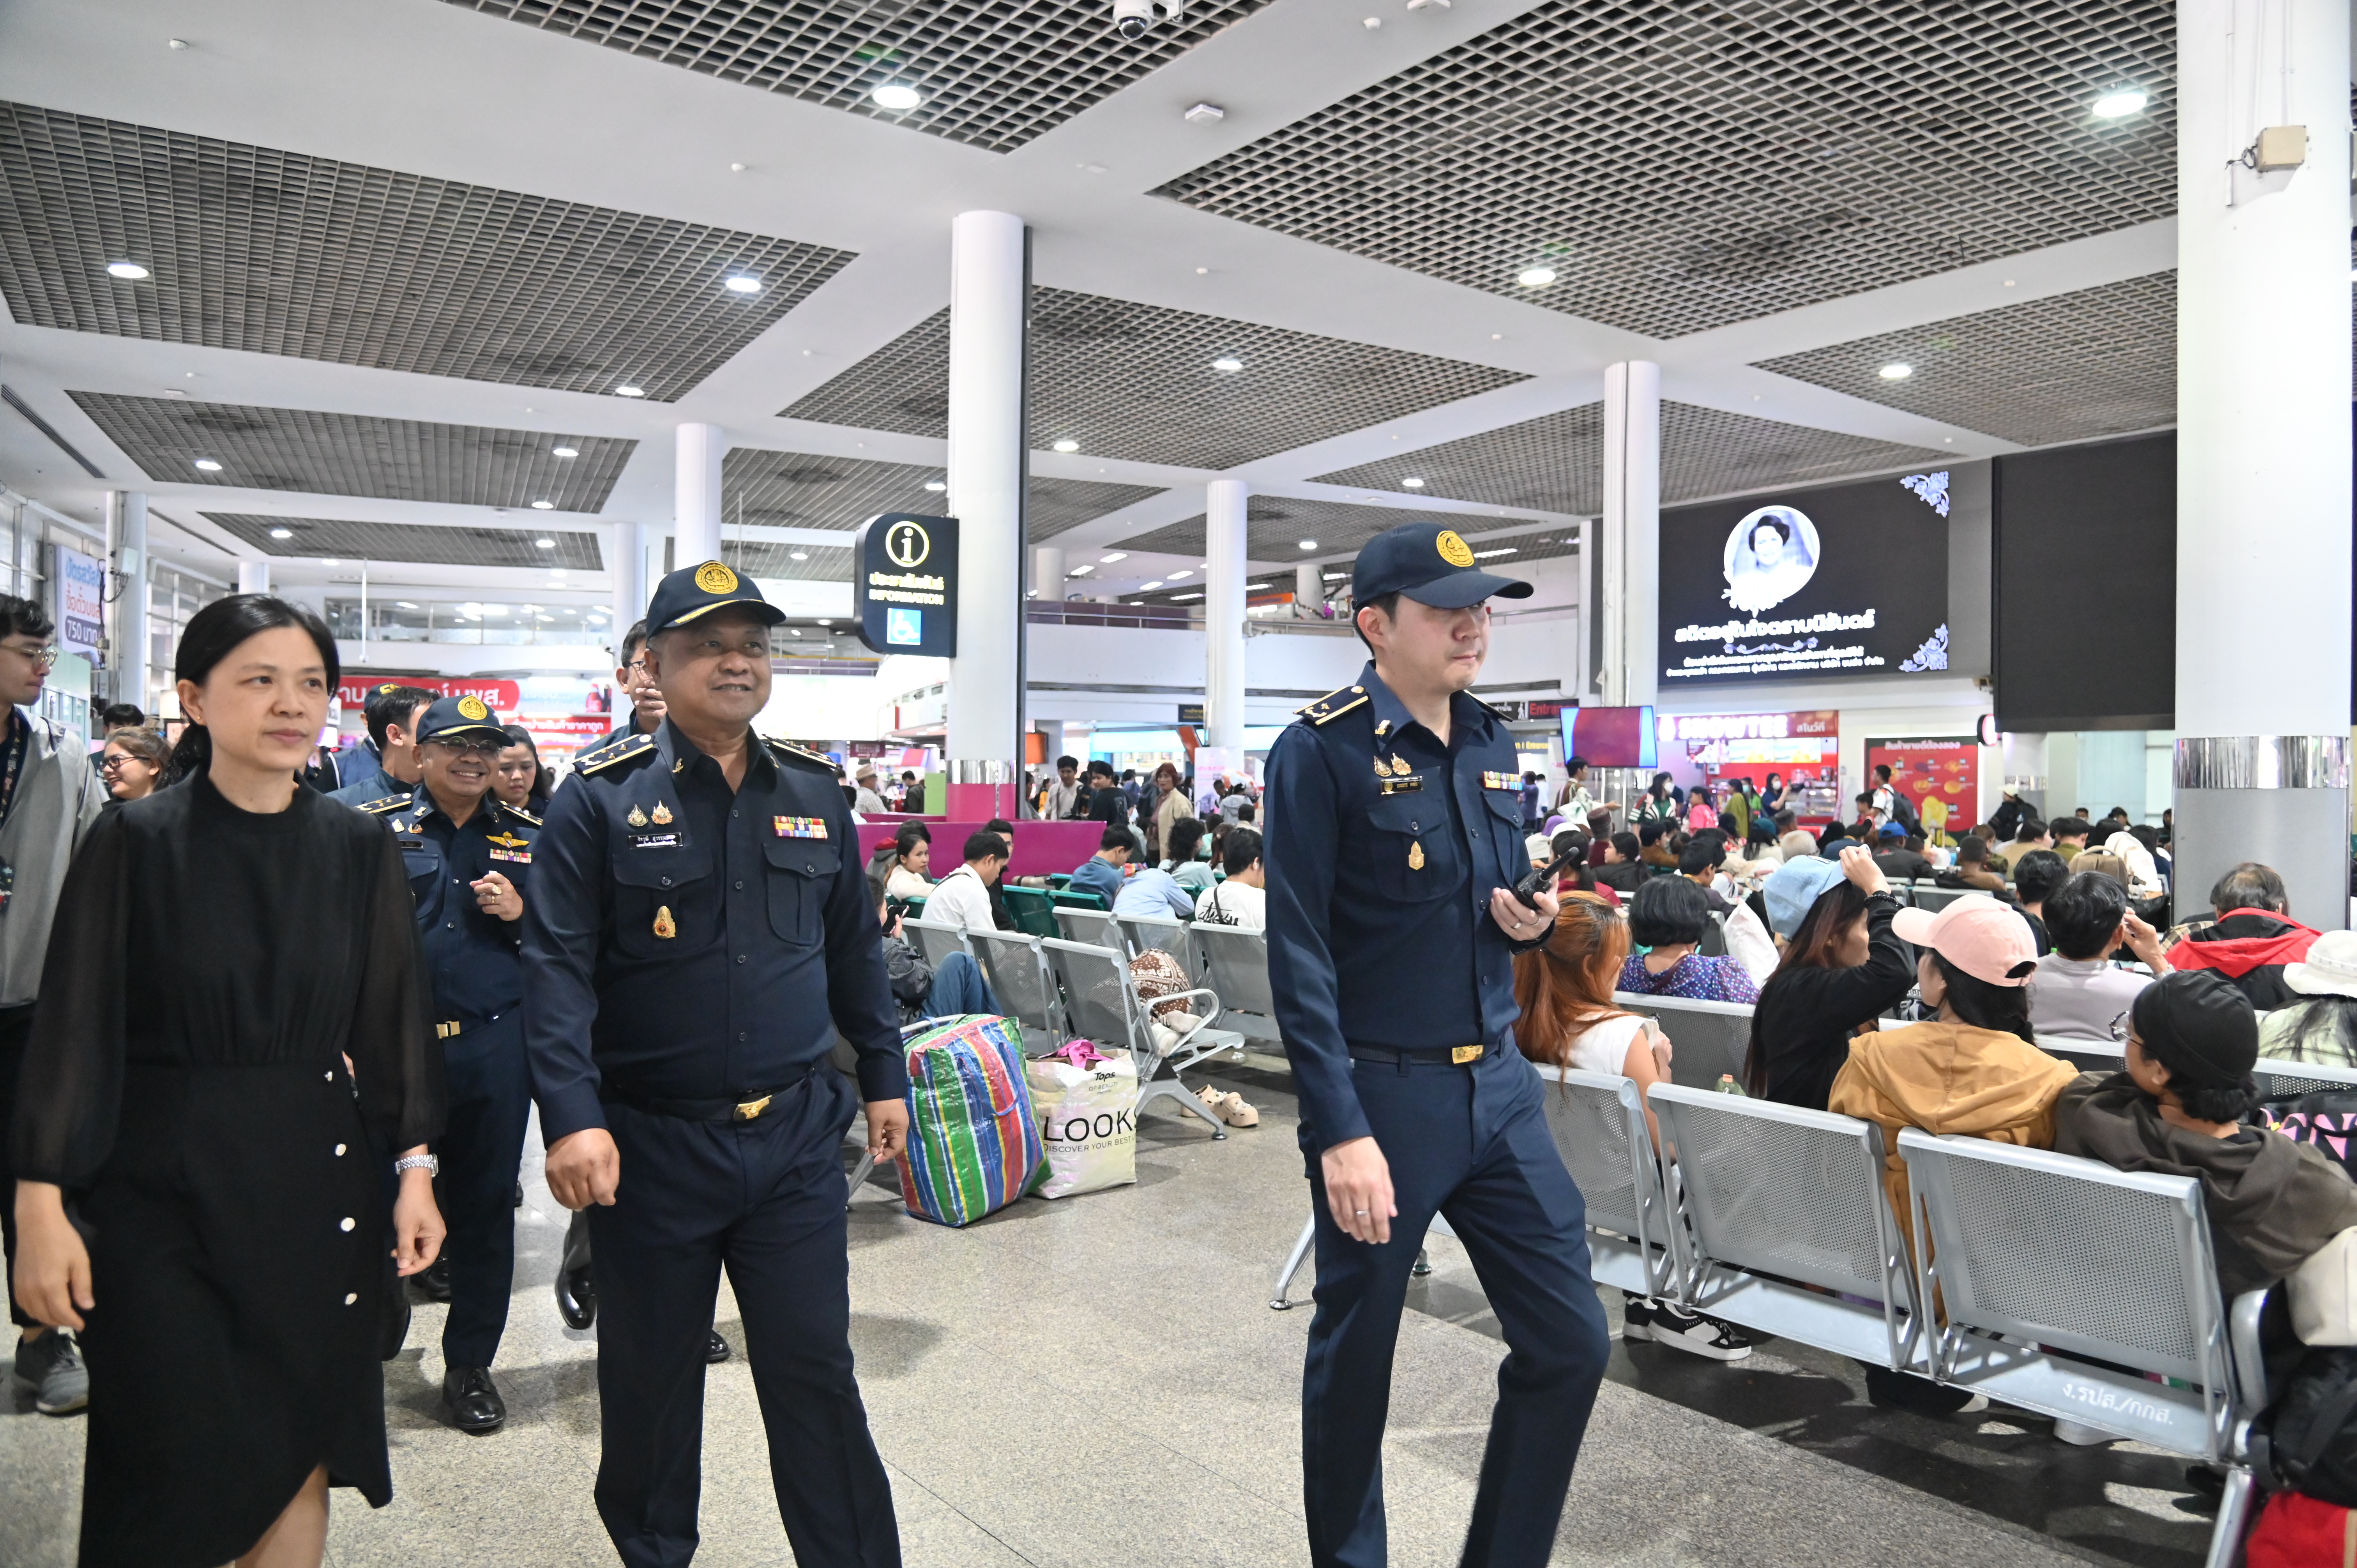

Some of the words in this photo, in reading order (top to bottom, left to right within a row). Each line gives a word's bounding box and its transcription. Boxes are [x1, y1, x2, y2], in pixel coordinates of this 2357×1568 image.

[869, 589, 944, 605] INFORMATION
[67, 620, 82, 640] 750
[1529, 703, 1576, 715] Entra
[1678, 715, 1788, 740] SNOWTEE
[1094, 1072, 1116, 1082] Tops
[1043, 1108, 1137, 1142] LOOK
[1043, 1144, 1089, 1153] DISCOVER
[1092, 1140, 1112, 1150] YOUR
[1115, 1135, 1131, 1146] BEST
